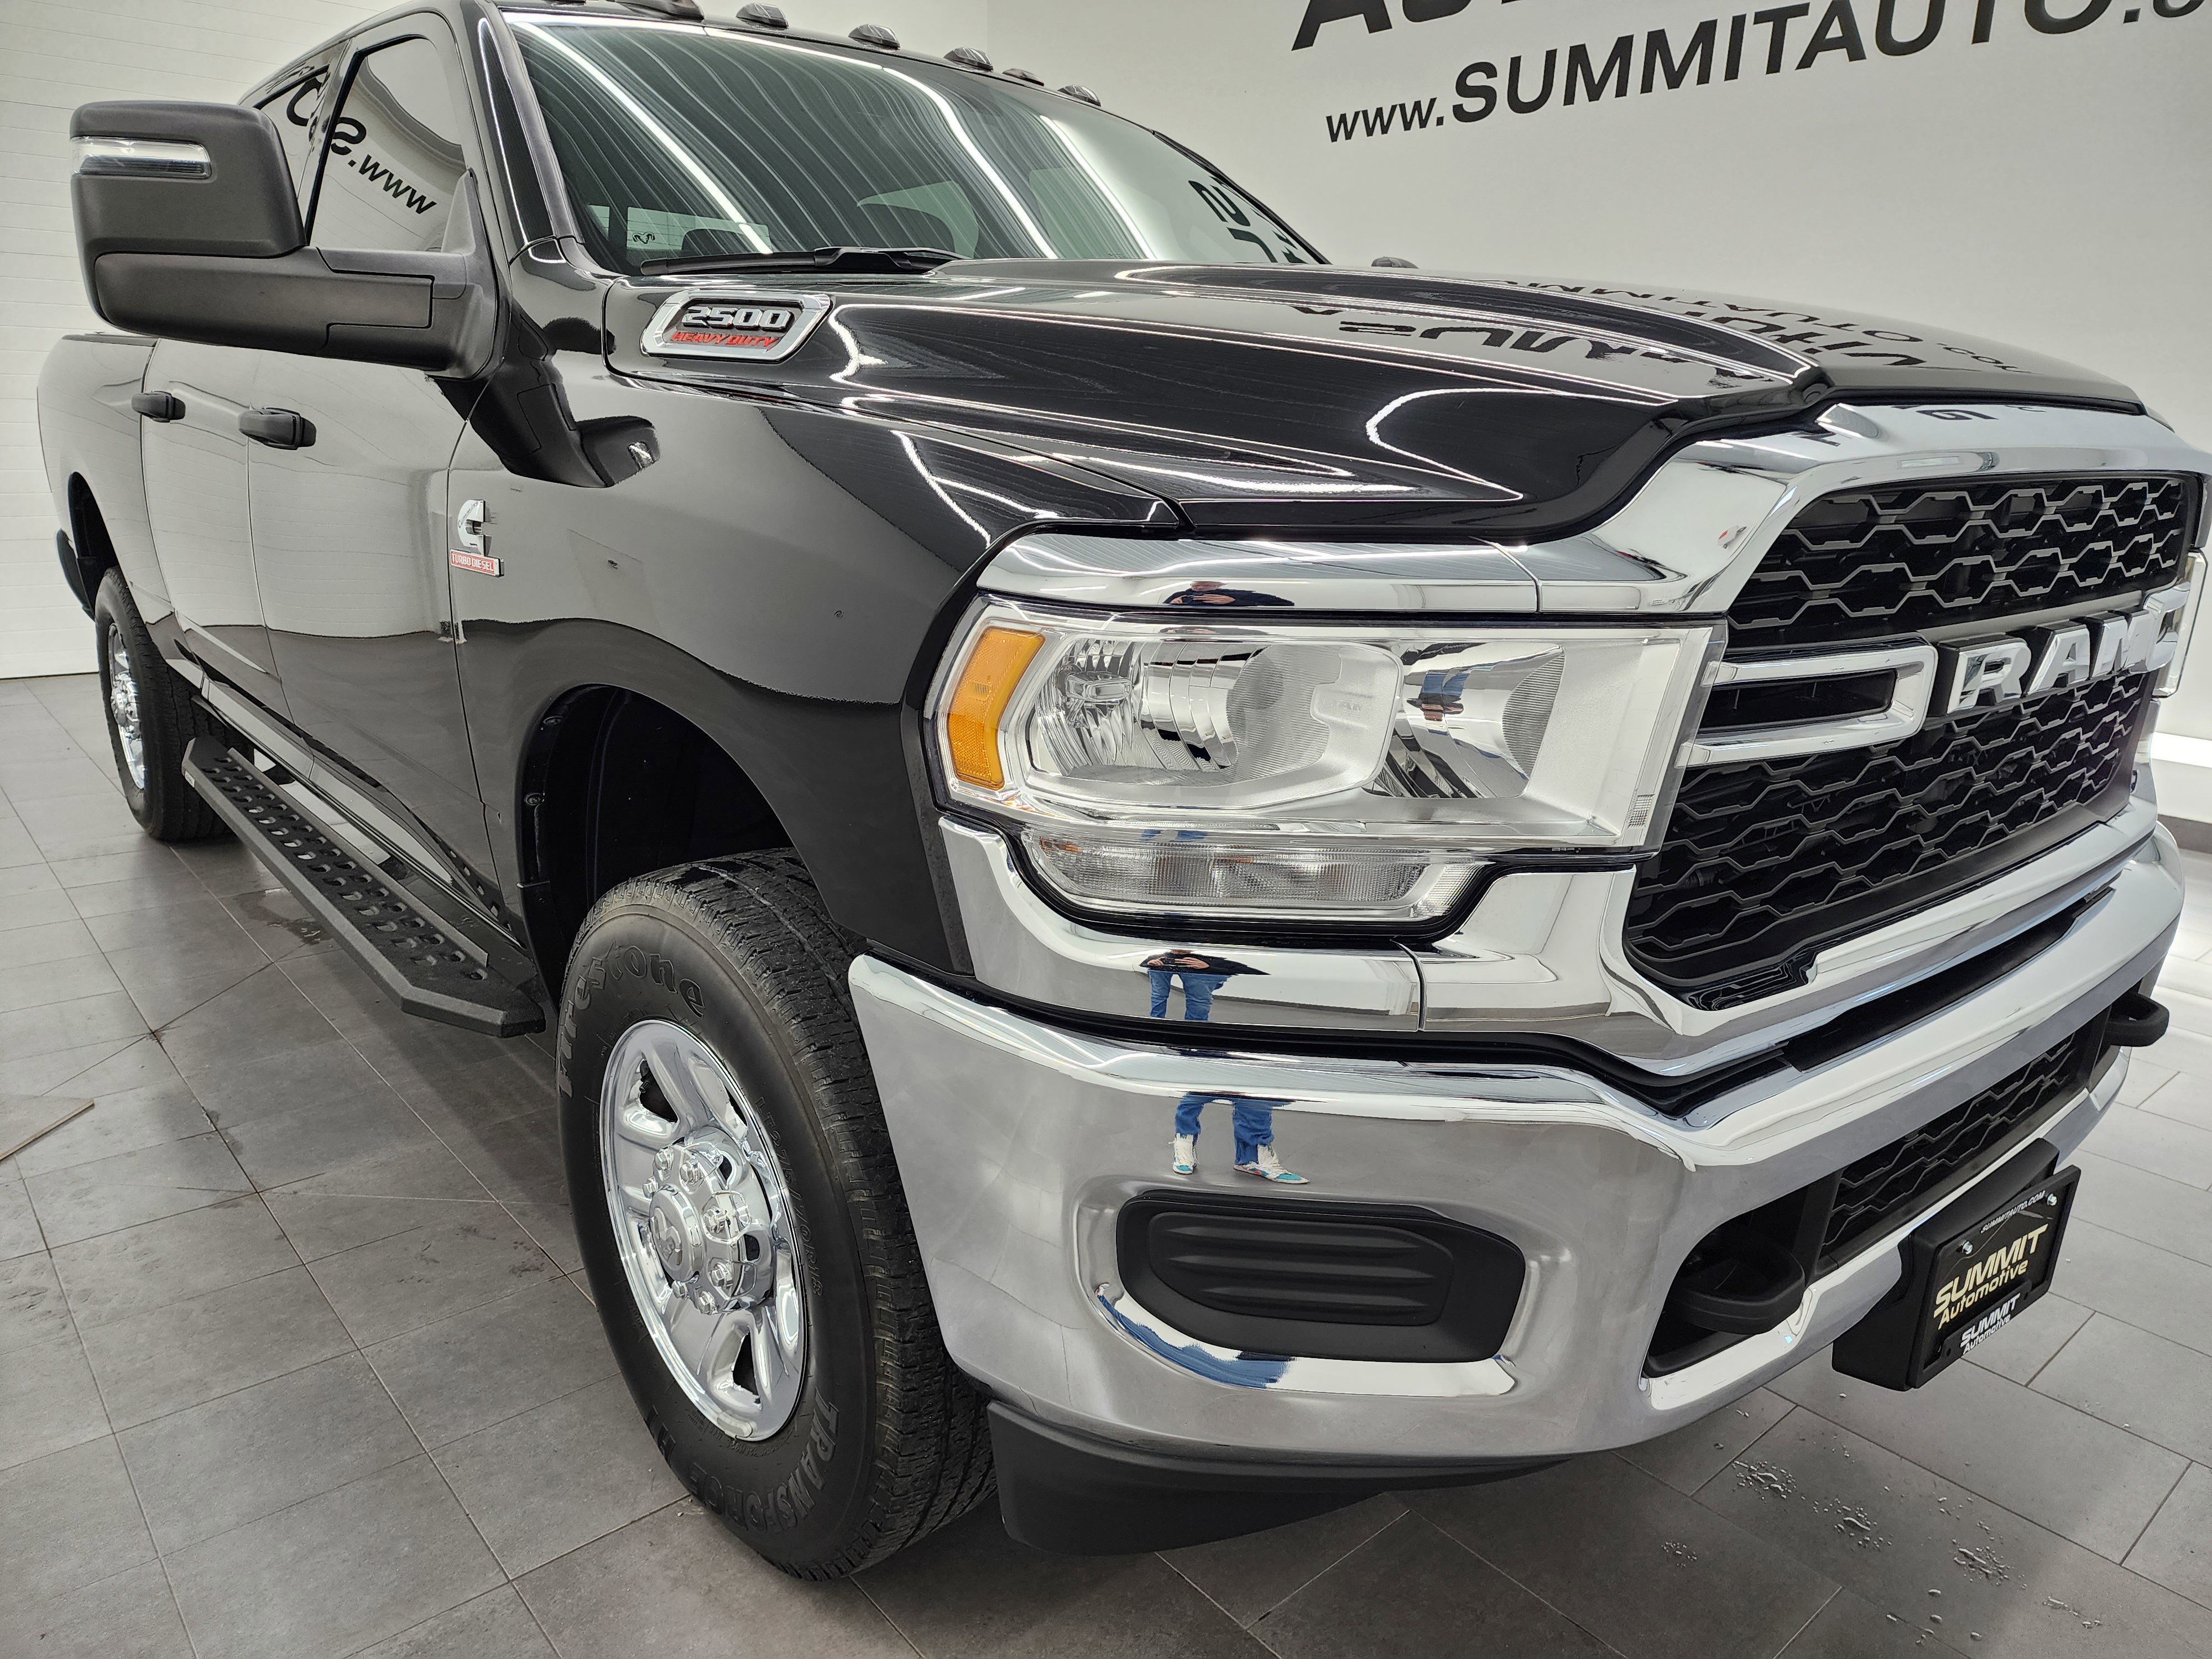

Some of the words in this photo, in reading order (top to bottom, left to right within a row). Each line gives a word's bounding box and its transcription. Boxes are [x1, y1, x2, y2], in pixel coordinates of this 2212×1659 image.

[671, 331, 729, 345] HEAVY
[726, 335, 778, 347] DUTY
[681, 306, 794, 331] 2500
[458, 502, 479, 528] Cummins
[451, 553, 472, 566] TURBO
[471, 558, 494, 572] DIESEL
[1939, 608, 2151, 714] RAM
[1980, 1190, 2046, 1234] SUMMITAUTO.COM
[1933, 1224, 2049, 1318] SUMMIT
[1938, 1259, 2028, 1330] Automotive
[1960, 1292, 2021, 1348] SUMMIT
[1962, 1313, 2011, 1355] Automotive
